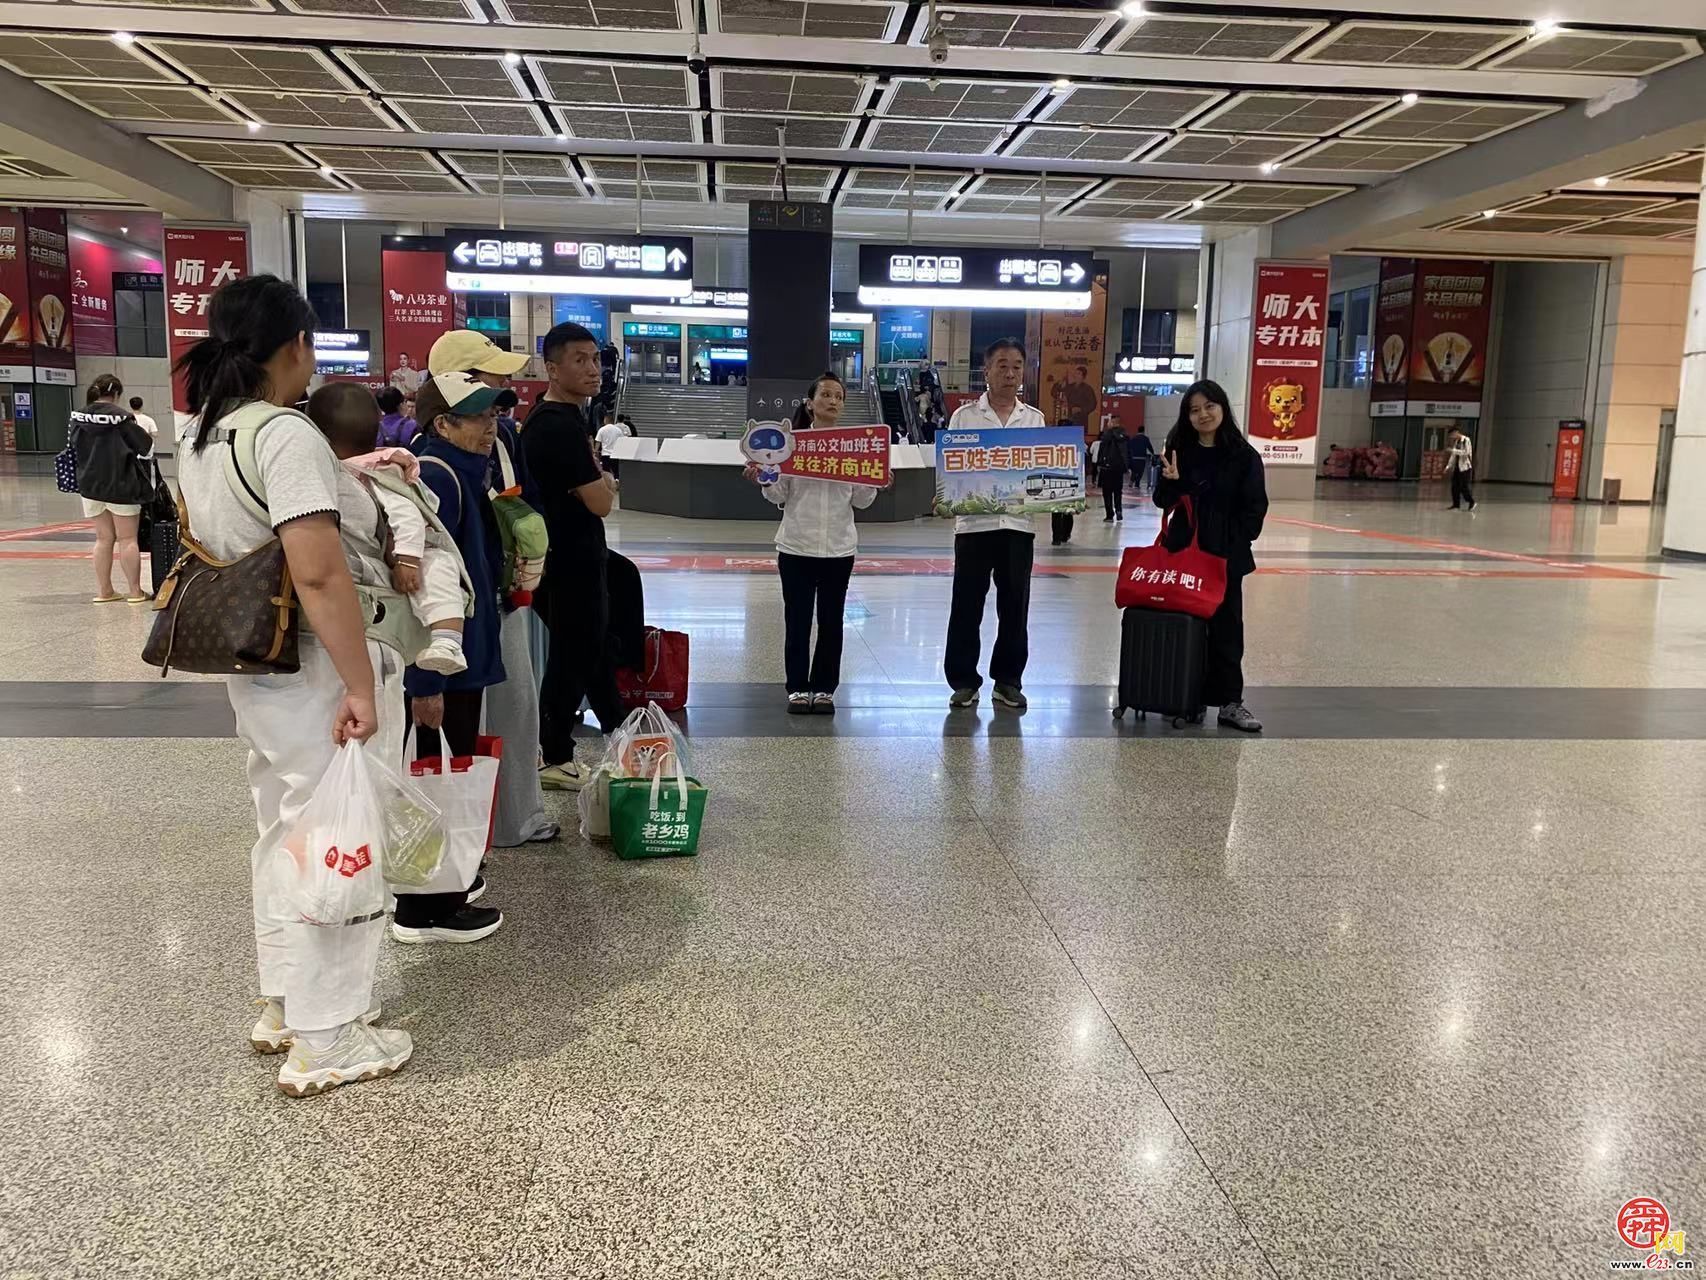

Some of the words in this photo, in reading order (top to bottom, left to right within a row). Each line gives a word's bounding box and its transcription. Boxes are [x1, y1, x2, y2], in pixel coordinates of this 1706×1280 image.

[503, 241, 542, 257] 出租车
[174, 258, 240, 287] 师大
[1000, 259, 1037, 275] 出租车
[406, 293, 447, 306] 八马茶业
[1262, 293, 1320, 320] 师大
[1256, 325, 1323, 347] 专升本
[797, 436, 886, 453] 济南公交加班车
[943, 444, 1078, 471] 百姓专职司机
[792, 456, 884, 479] 发往济南站
[641, 823, 689, 839] 老乡鸡
